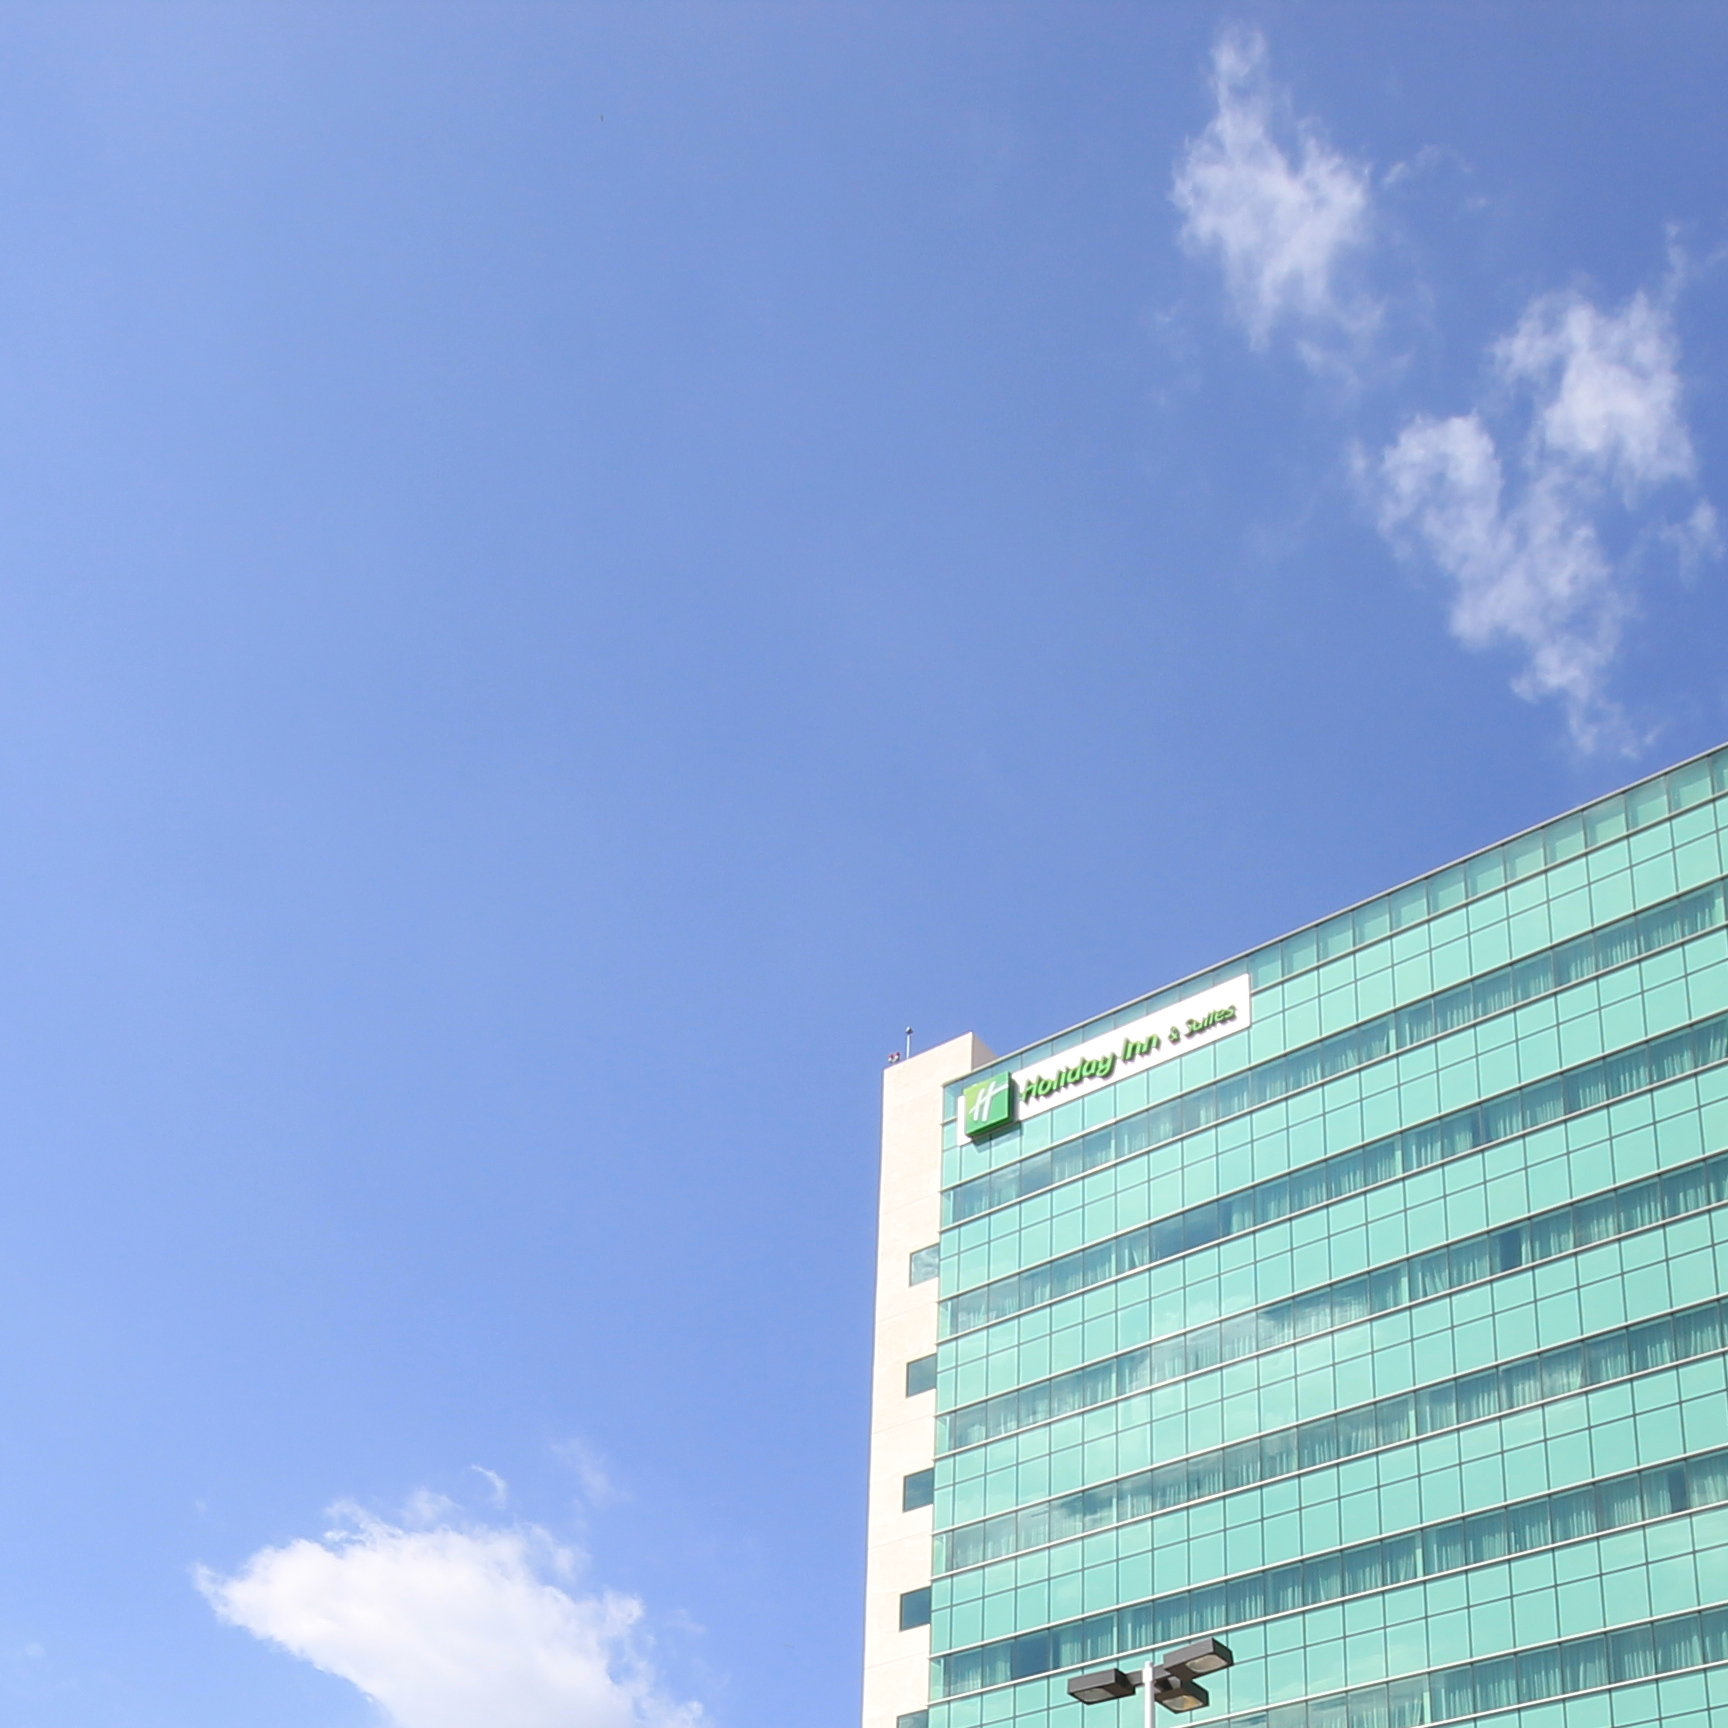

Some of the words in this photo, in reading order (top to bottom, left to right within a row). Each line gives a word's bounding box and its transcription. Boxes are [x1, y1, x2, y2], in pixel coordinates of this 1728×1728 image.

[1020, 1053, 1114, 1103] Holiday
[1122, 1034, 1160, 1062] Inn
[1168, 1026, 1181, 1043] &
[1185, 1005, 1237, 1037] Suites
